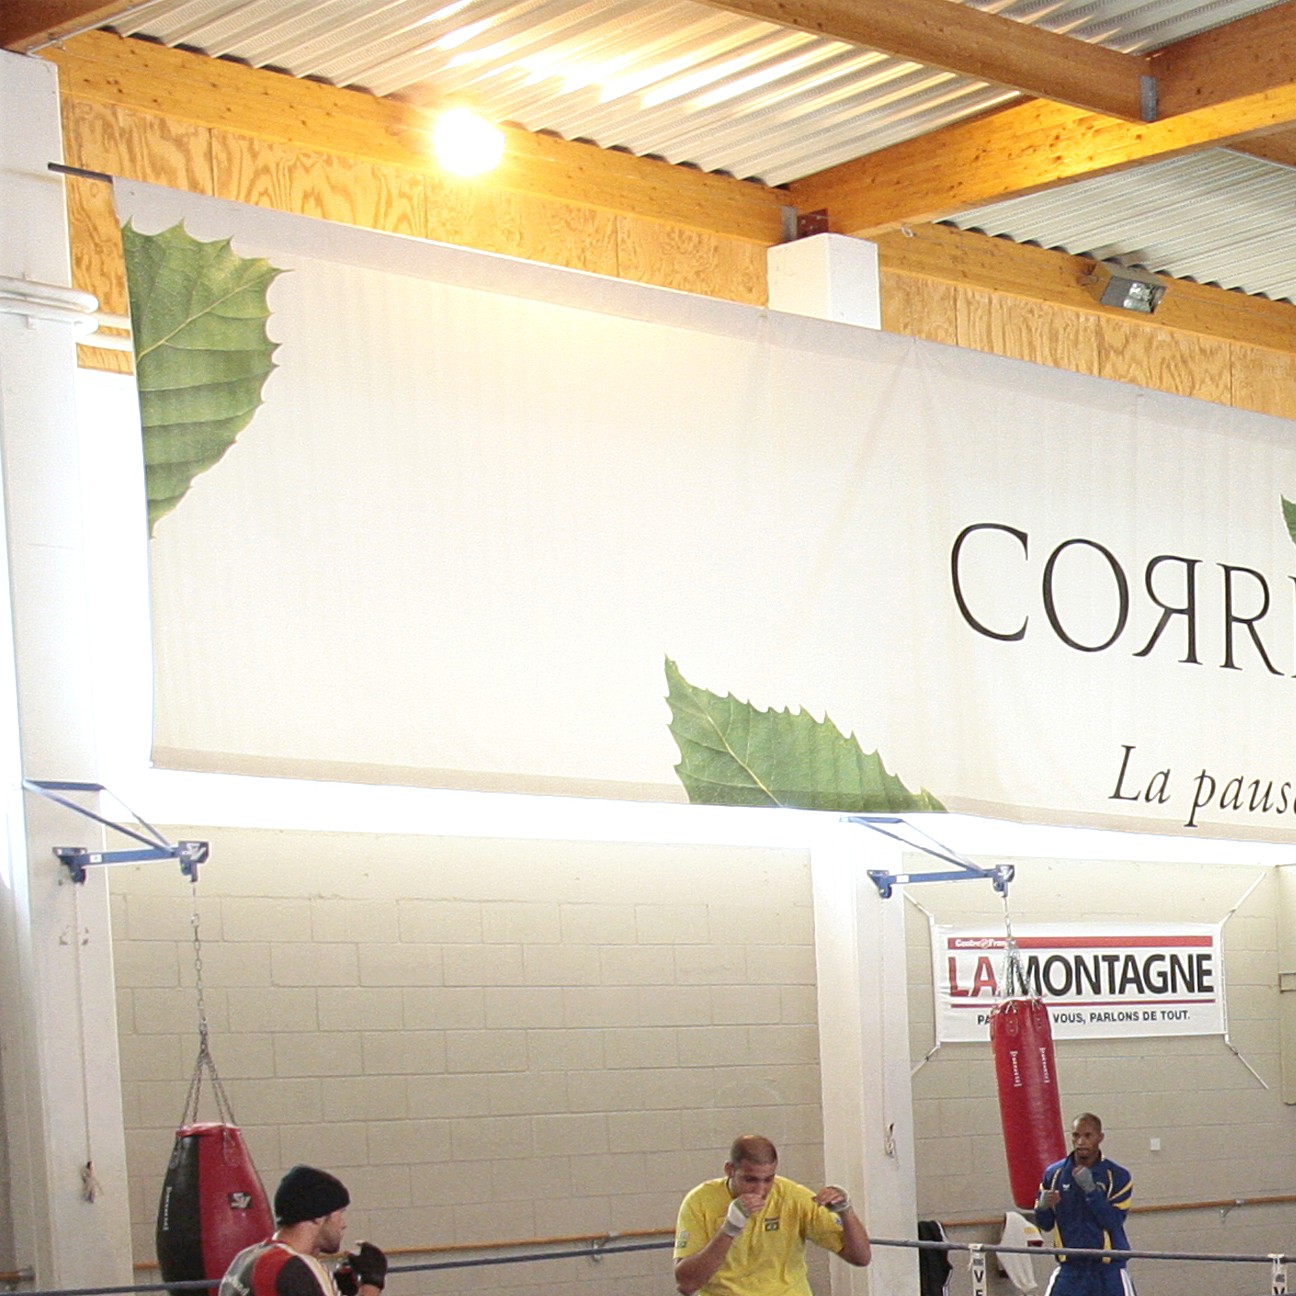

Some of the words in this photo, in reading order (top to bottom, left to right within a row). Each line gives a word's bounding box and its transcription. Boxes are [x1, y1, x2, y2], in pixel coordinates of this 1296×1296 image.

[1108, 744, 1172, 804] La
[948, 956, 998, 997] LA
[1007, 953, 1214, 997] MONTAGNE
[1053, 1012, 1086, 1024] VOUS,
[1090, 1011, 1139, 1023] PARLONS
[1143, 1010, 1157, 1021] DE
[1161, 1010, 1191, 1021] TOUT.
